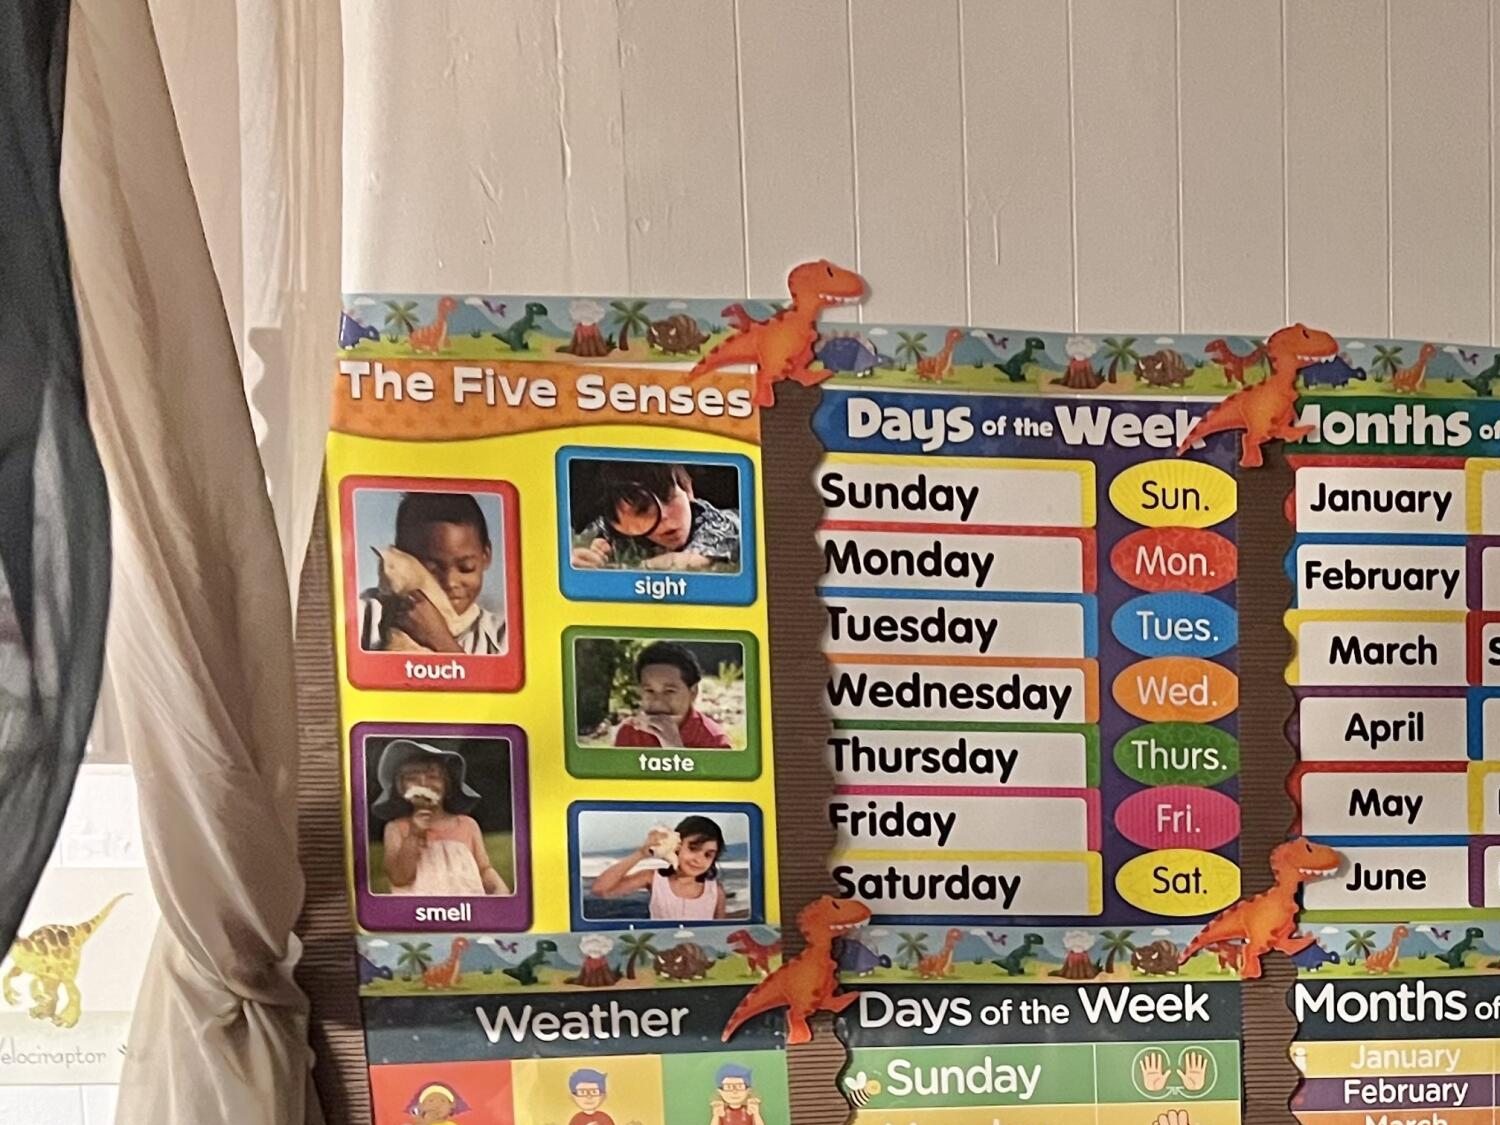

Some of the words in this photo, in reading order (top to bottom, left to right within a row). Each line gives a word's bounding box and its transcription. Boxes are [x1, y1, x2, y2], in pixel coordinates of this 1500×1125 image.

[340, 362, 434, 402] The
[454, 367, 557, 408] Five
[576, 375, 753, 418] Senses
[846, 398, 973, 452] Days
[982, 417, 1010, 436] of
[1013, 416, 1053, 438] the
[1055, 405, 1205, 451] Week
[821, 473, 979, 520] Sunday
[1141, 481, 1210, 512] Sun.
[1310, 484, 1452, 521] January
[825, 540, 994, 587] Monday
[1135, 551, 1216, 577] Mon.
[1305, 561, 1460, 599] February
[634, 577, 686, 600] sight
[826, 606, 997, 653] Tuesday
[1137, 611, 1219, 641] Tues.
[1329, 635, 1437, 665] March
[405, 660, 465, 681] touch
[827, 672, 1072, 720] Wednesday
[1137, 677, 1217, 706] Wed.
[1345, 713, 1424, 749] April
[638, 754, 694, 772] taste
[828, 737, 1018, 784] Thursday
[1131, 740, 1227, 771] Thurs.
[830, 802, 956, 846] Friday
[1157, 804, 1200, 834] Fri.
[1349, 789, 1423, 824] May
[832, 865, 1021, 909] Saturday
[1152, 867, 1207, 894] Sat.
[1346, 863, 1427, 891] June
[415, 904, 472, 923] smell
[859, 990, 971, 1035] Days
[980, 1000, 1012, 1025] of
[1020, 999, 1069, 1025] the
[1078, 984, 1209, 1025] Week
[1294, 981, 1467, 1023] Months
[475, 1001, 688, 1043] Weather
[0, 1038, 106, 1067] elociraptor
[1351, 1044, 1460, 1070] January
[887, 1056, 1041, 1099] Sunday
[1344, 1080, 1468, 1106] February
